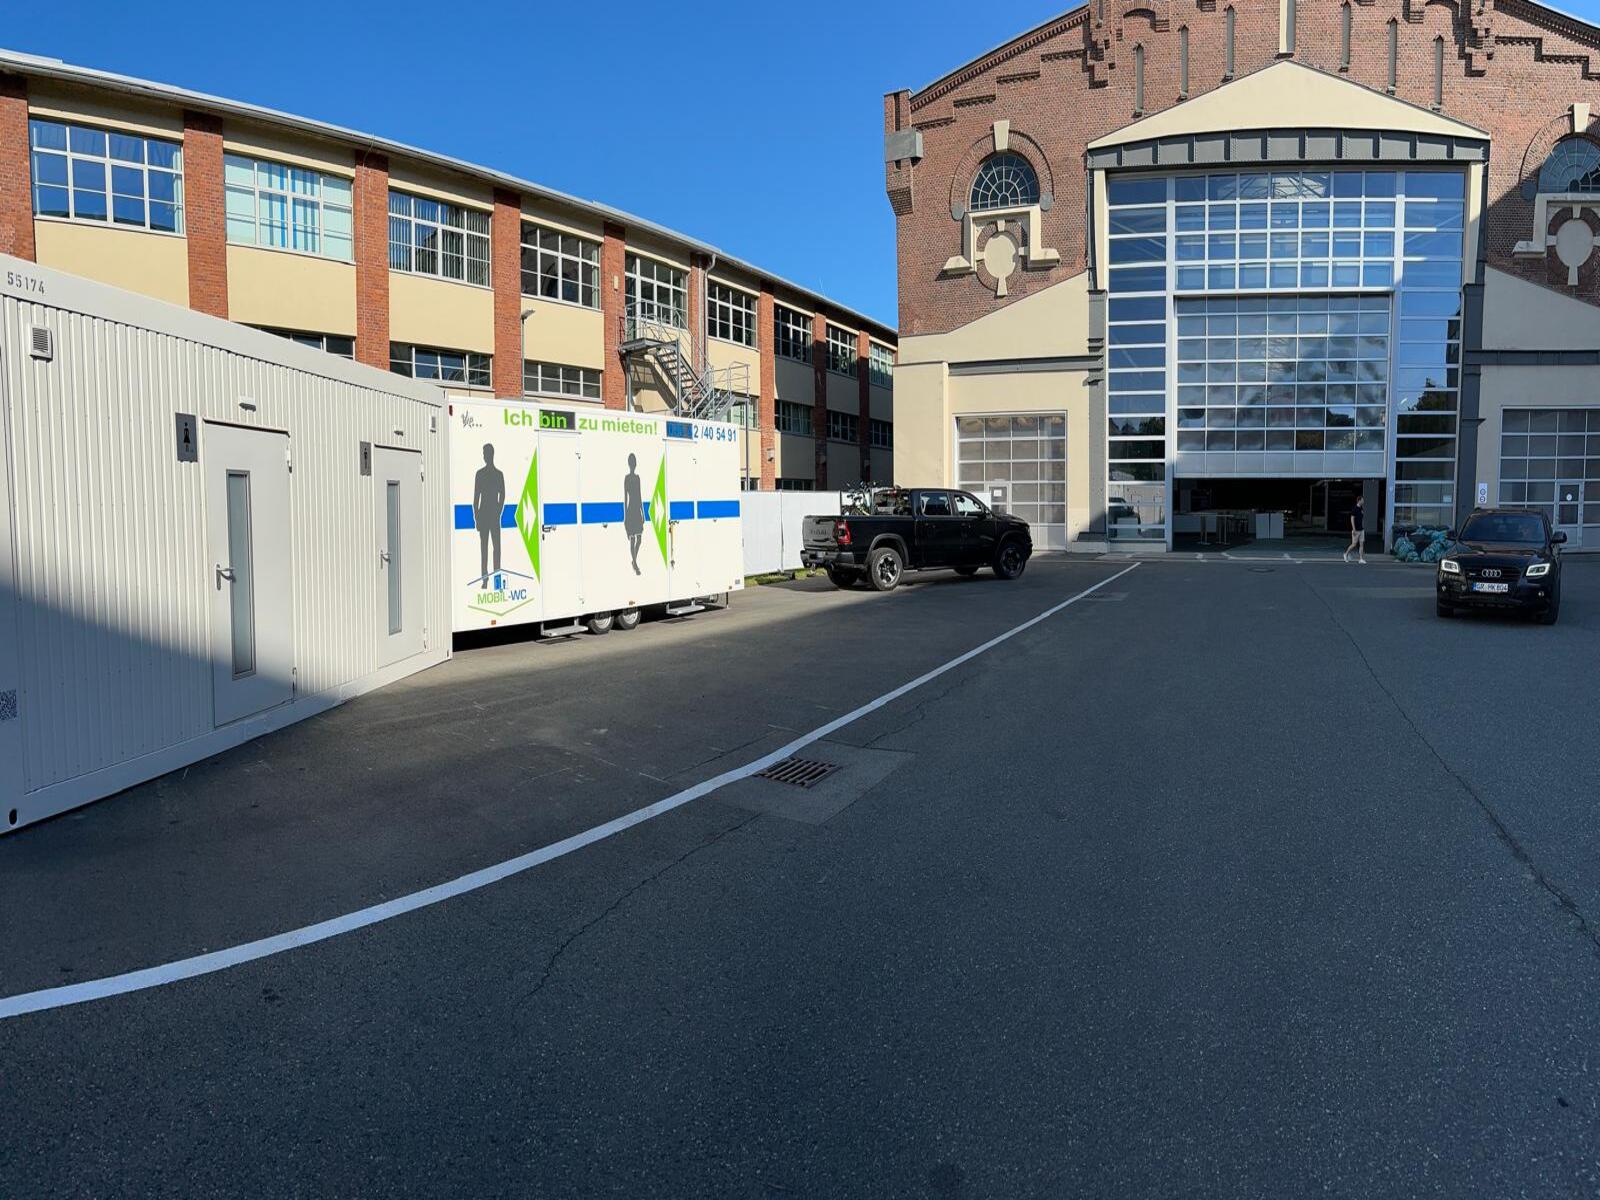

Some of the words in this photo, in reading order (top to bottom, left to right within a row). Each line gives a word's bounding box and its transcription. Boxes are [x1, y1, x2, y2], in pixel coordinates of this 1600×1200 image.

[7, 271, 45, 295] 55174
[504, 408, 533, 426] Ich
[539, 410, 567, 428] bin
[579, 418, 598, 431] zu
[602, 418, 657, 435] mieten!
[716, 427, 726, 441] 54
[727, 428, 737, 442] 91
[477, 589, 527, 605] MOBIL-WC
